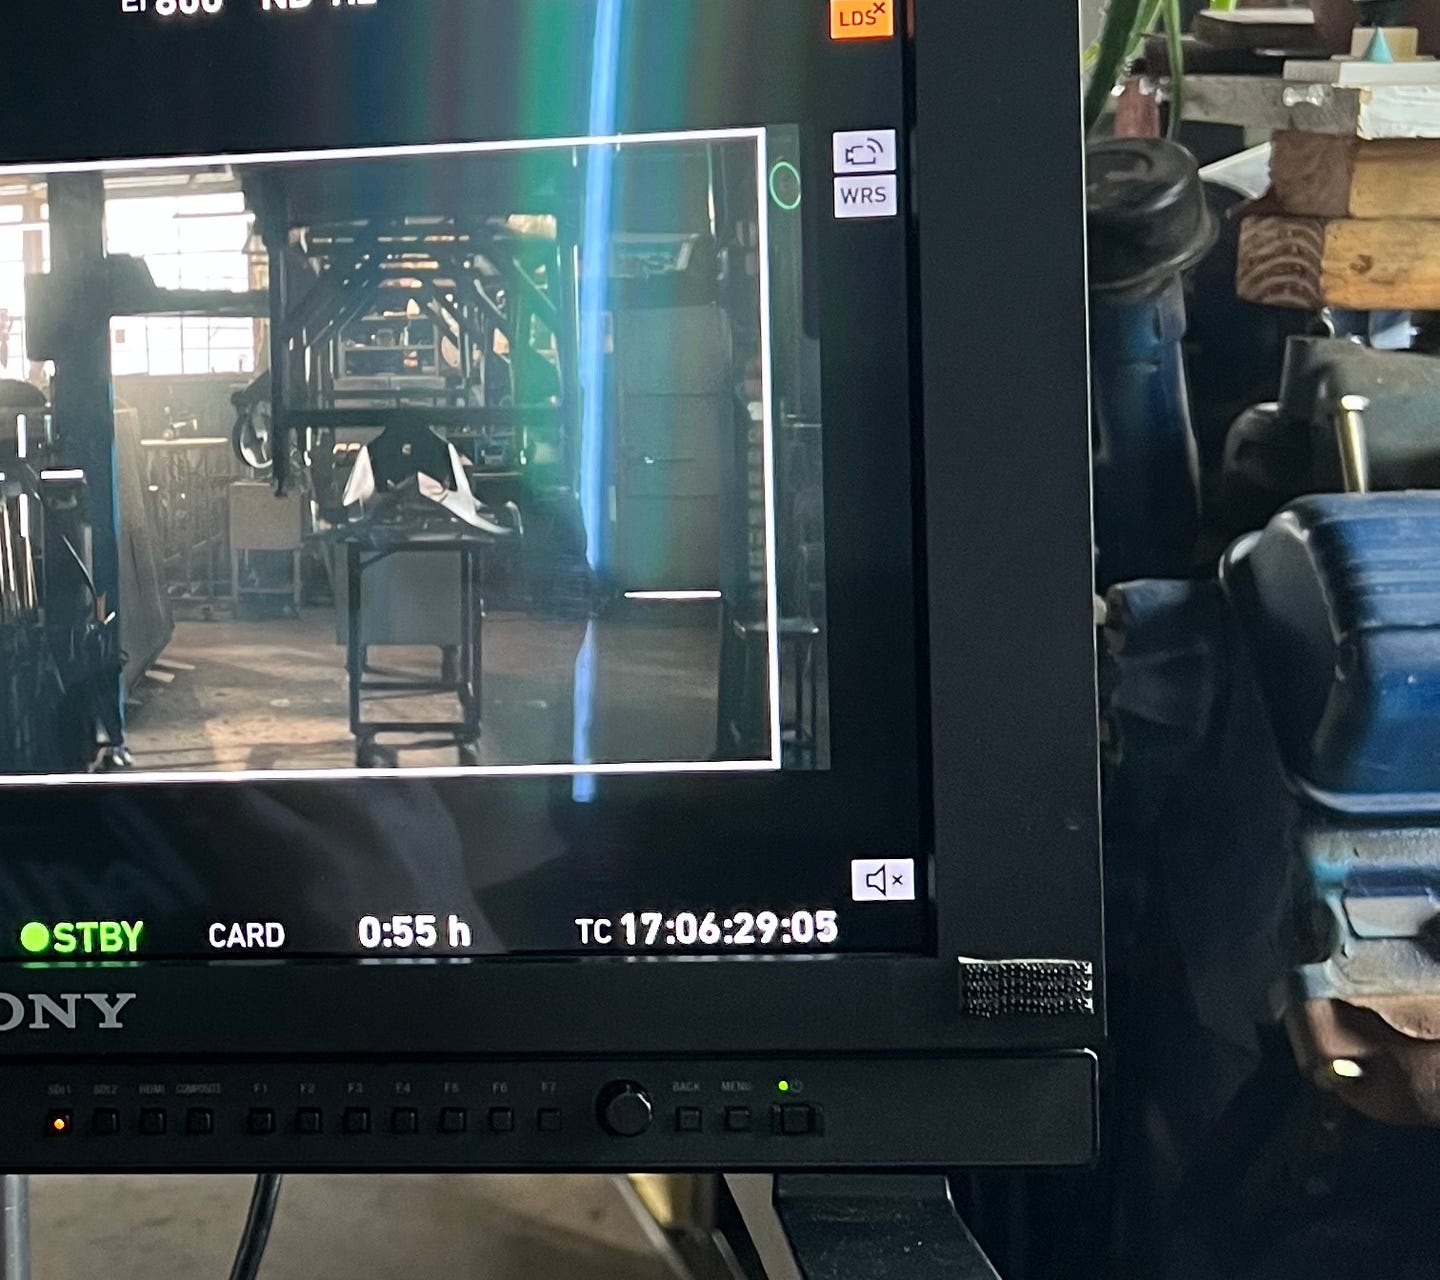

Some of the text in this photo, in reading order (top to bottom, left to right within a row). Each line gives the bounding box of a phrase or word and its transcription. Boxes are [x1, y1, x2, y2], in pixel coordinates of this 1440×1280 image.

[840, 186, 887, 205] WRS
[52, 920, 145, 954] STBY
[208, 921, 286, 949] CARD
[357, 914, 437, 948] 0:55
[447, 914, 472, 948] h
[574, 918, 613, 945] TC
[620, 910, 839, 947] 17:06:29:05
